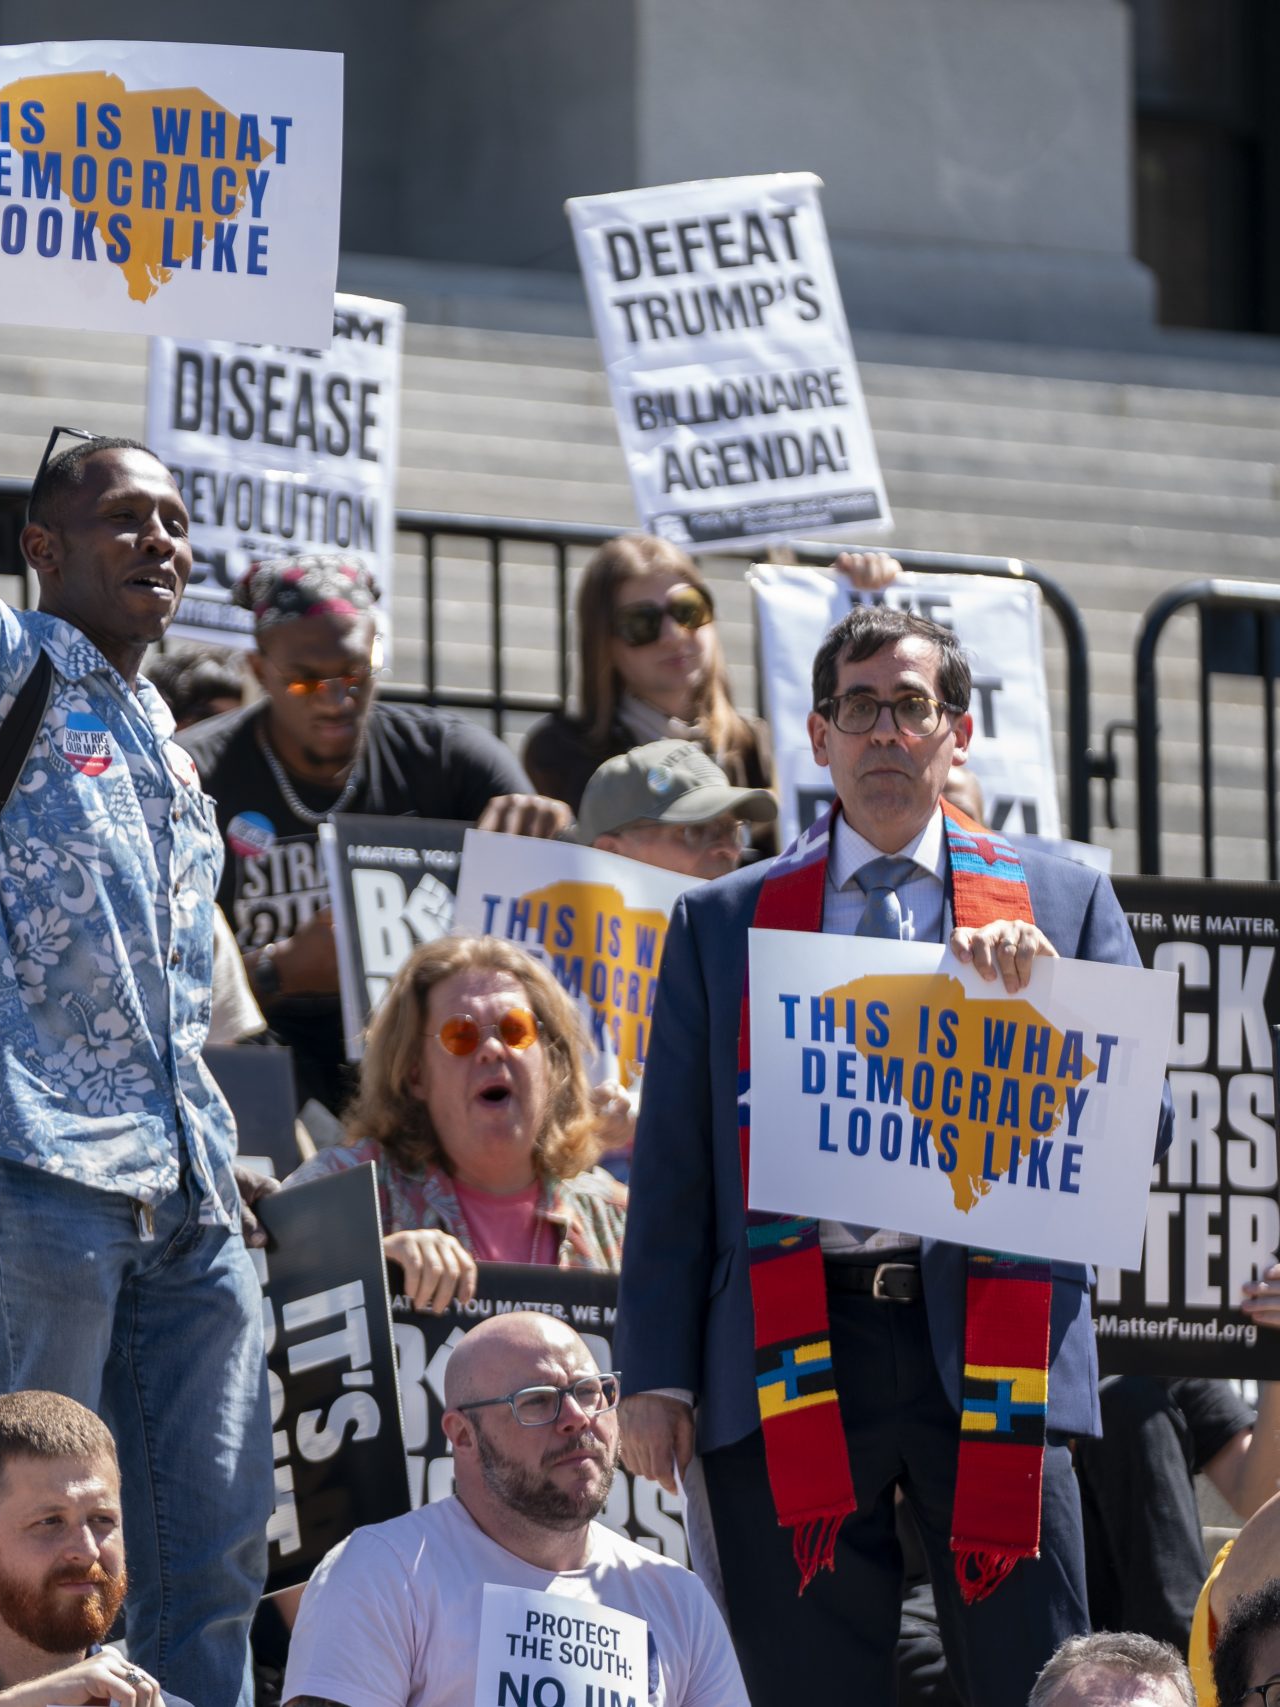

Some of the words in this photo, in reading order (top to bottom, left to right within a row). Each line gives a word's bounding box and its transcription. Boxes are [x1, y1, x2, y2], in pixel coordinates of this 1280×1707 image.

[76, 101, 122, 150] IS
[152, 106, 293, 165] WHAT
[162, 217, 268, 276] LIKE
[606, 204, 799, 281] DEFEAT
[615, 273, 821, 343] TRUMP'S
[174, 348, 379, 462] DISEASE
[632, 366, 848, 431] BILLIONAIRE
[665, 425, 849, 493] AGENDA!
[65, 729, 89, 743] DON'T
[91, 733, 108, 743] RIG
[66, 741, 82, 752] OUR
[84, 744, 111, 755] MAPS
[424, 849, 460, 870] YOU
[483, 894, 576, 947] THIS
[596, 912, 623, 958] IS
[1172, 914, 1200, 930] WE
[1206, 913, 1279, 933] MATTER.
[779, 994, 890, 1047] THIS
[918, 1006, 959, 1059] IS
[983, 1017, 1118, 1084] WHAT
[801, 1046, 1089, 1136] DEMOCRACY
[818, 1102, 959, 1173] LOOKS
[982, 1131, 1084, 1194] LIKE
[453, 1298, 491, 1315] YOU
[572, 1304, 599, 1322] WE
[1091, 1314, 1258, 1346] sMatterFund.org
[282, 1279, 381, 1463] IT'S
[506, 1633, 553, 1661] THE
[559, 1641, 633, 1680] SOUTH:
[526, 1610, 620, 1650] PROTECT
[497, 1670, 566, 1707] NO
